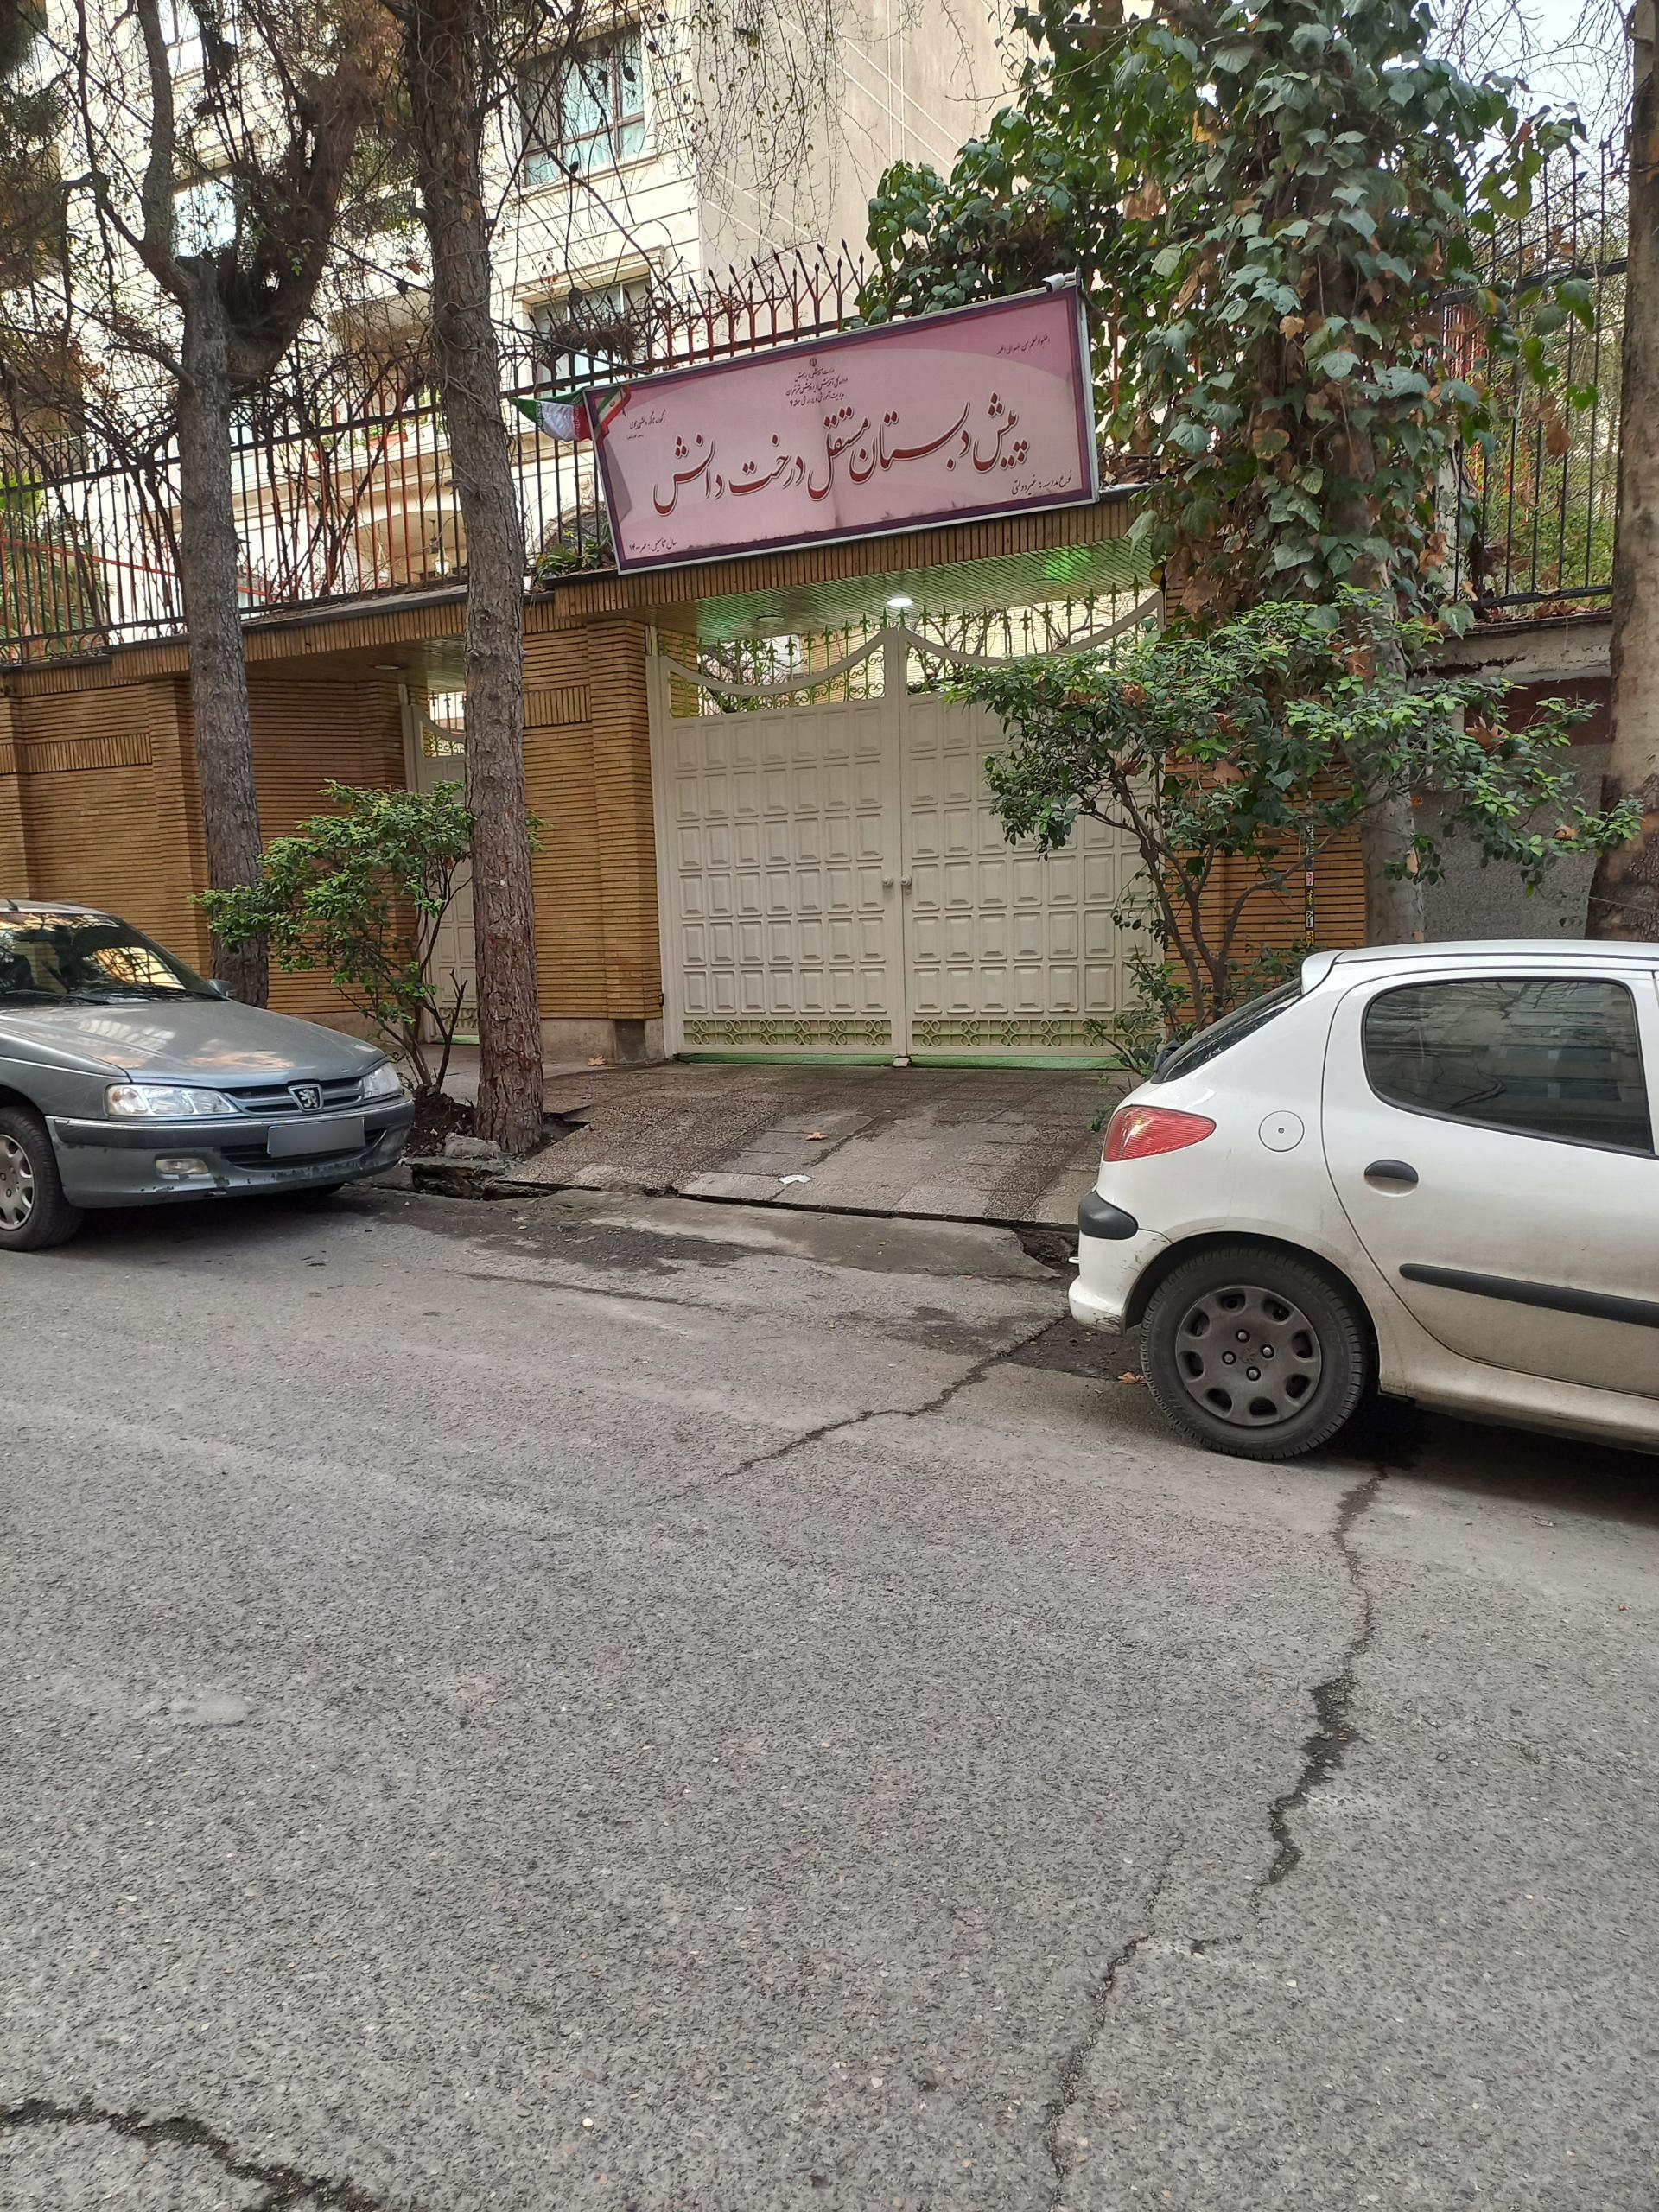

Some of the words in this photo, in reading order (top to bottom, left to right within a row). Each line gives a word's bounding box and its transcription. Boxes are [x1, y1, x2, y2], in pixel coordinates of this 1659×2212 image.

[728, 433, 804, 496] درخت
[807, 405, 871, 501] مستقل
[849, 401, 971, 484] دبستان
[972, 391, 1029, 474] پیش
[652, 433, 725, 517] دانش
[1059, 469, 1072, 488] نوع
[666, 536, 677, 550] سال
